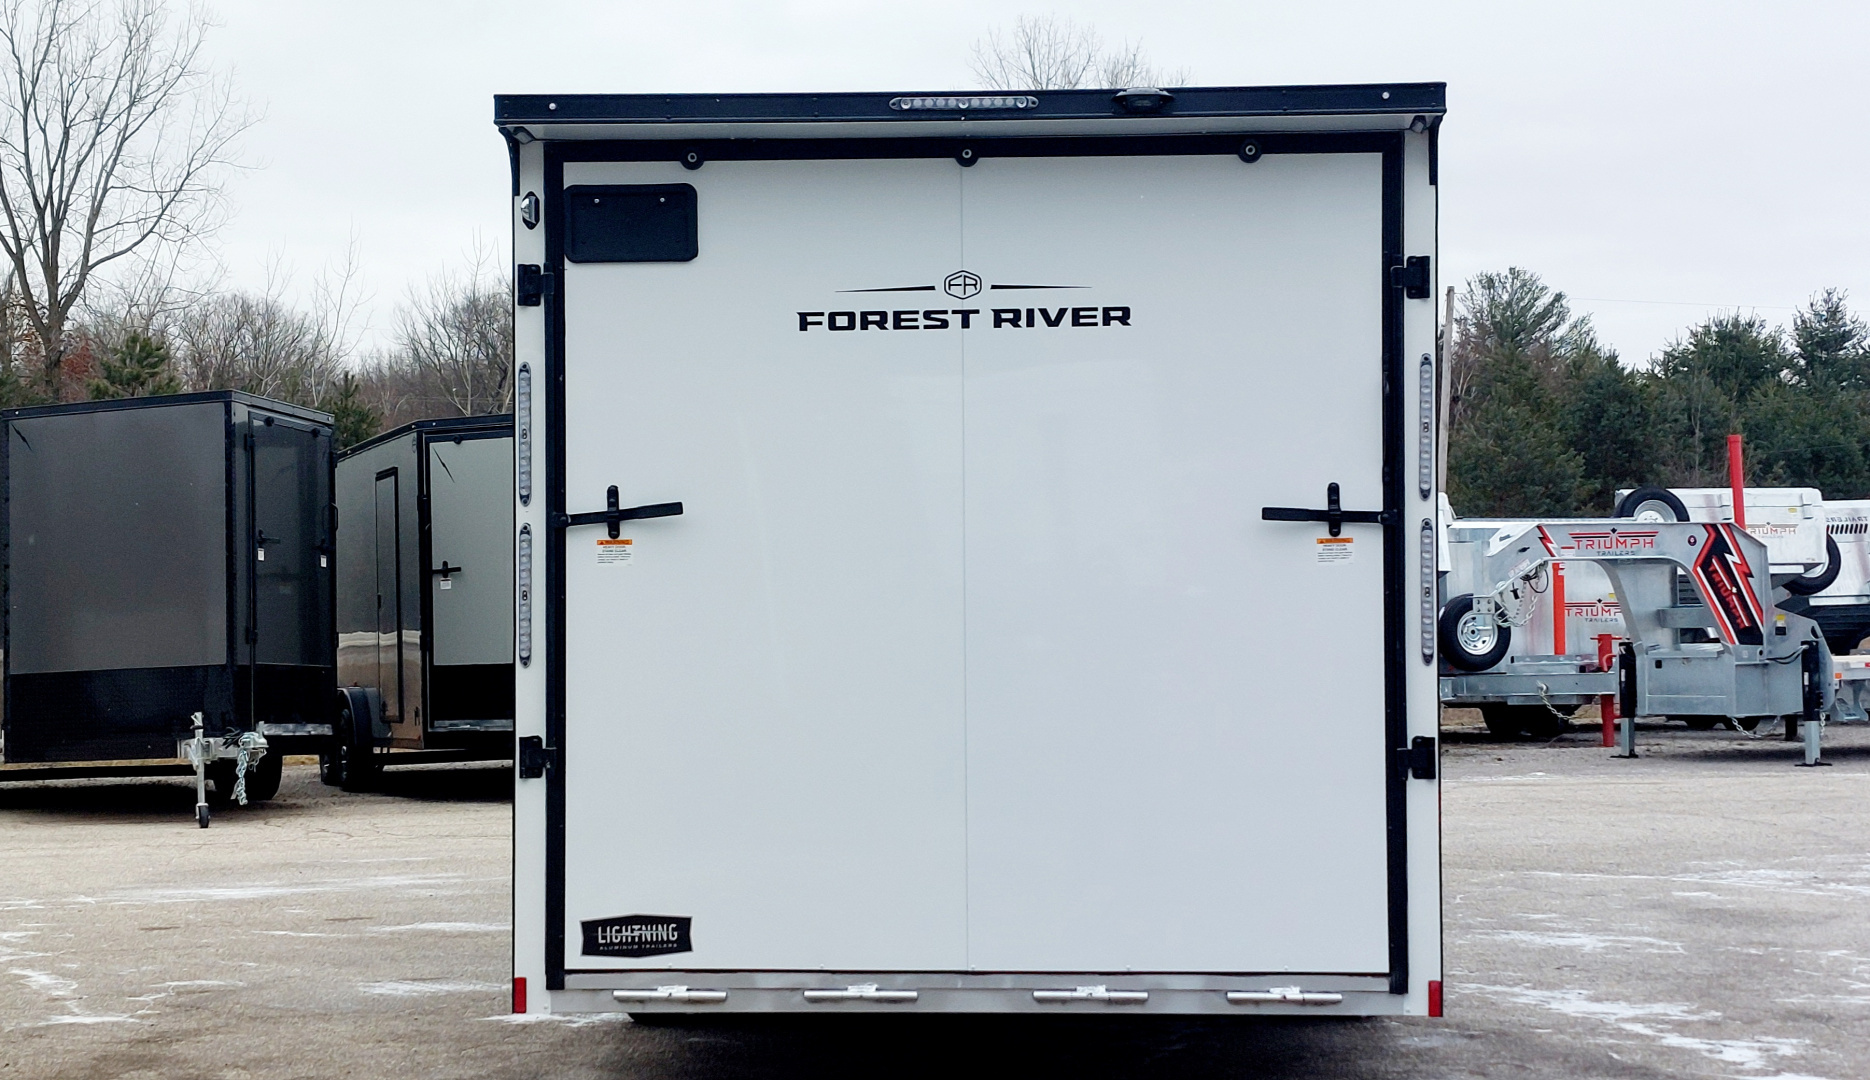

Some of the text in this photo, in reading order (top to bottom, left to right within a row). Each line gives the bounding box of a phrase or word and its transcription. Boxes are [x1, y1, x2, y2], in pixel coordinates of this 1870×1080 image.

[796, 306, 1132, 332] FOREST RIVER
[1750, 526, 1797, 535] RIUMPH
[1574, 536, 1654, 550] TRIUMPH
[1708, 562, 1746, 630] TRIUMPH
[1565, 606, 1621, 617] TRIUMP
[598, 923, 678, 944] LIGHTNING
